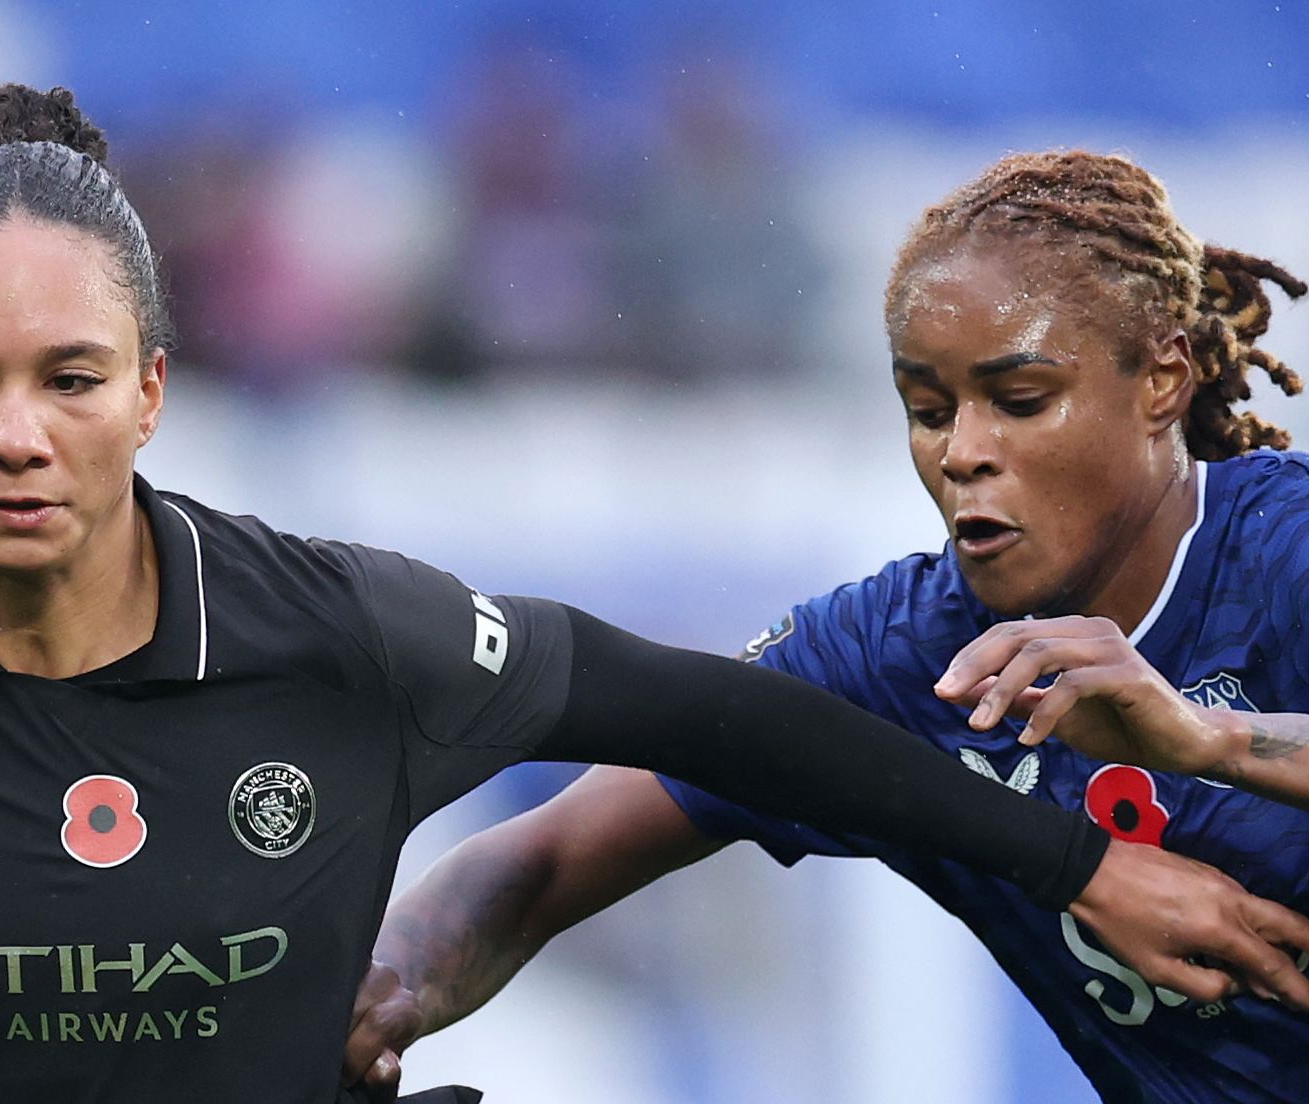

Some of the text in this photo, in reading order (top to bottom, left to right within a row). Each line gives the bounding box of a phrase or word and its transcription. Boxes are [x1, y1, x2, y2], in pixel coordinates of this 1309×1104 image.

[237, 769, 305, 803] MANCHESTER
[264, 838, 289, 850] CITY
[6, 1006, 219, 1042] AIRWAYS
